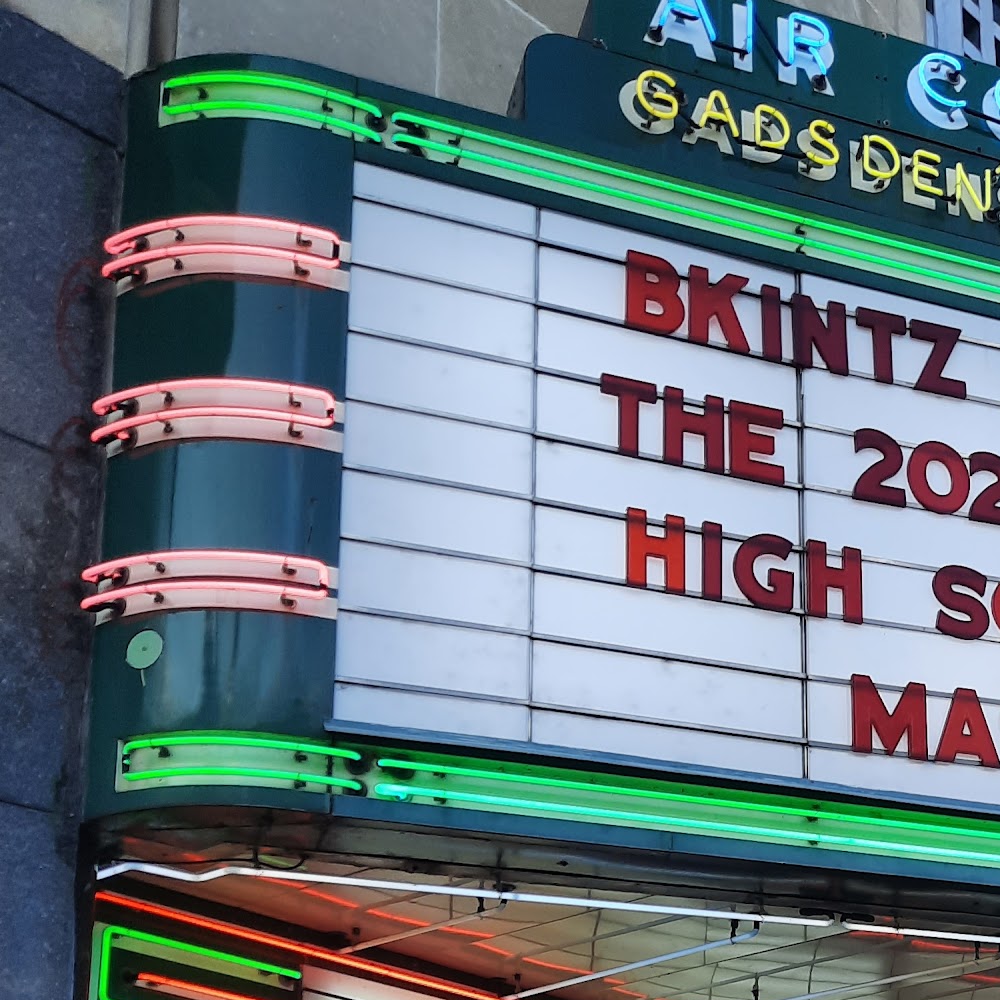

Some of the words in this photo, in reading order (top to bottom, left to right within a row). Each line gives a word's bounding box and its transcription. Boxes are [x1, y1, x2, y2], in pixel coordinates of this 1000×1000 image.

[642, 0, 836, 97] AIR
[624, 249, 968, 400] BKINTZ
[599, 372, 786, 487] THE
[625, 506, 864, 625] HIGH
